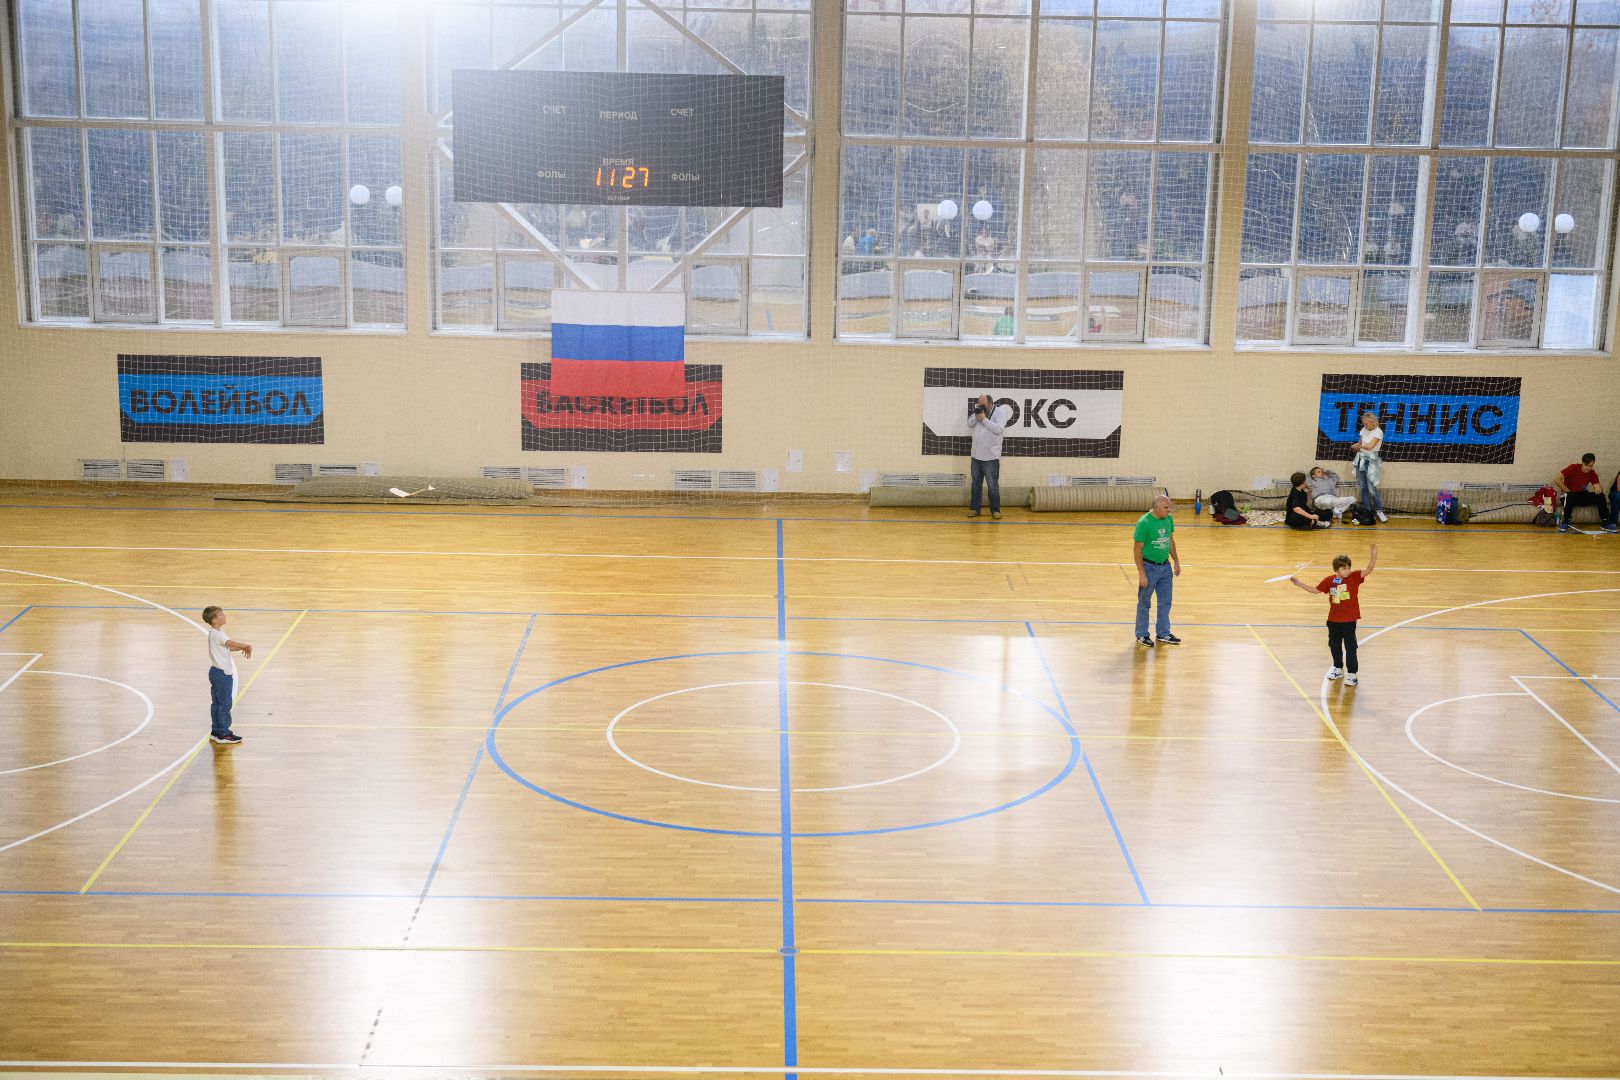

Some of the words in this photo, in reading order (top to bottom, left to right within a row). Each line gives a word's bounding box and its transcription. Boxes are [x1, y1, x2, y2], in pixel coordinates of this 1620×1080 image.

[599, 111, 638, 121] ПЕРИОД
[670, 108, 695, 117] СЧЕТ
[602, 157, 634, 166] ВРЕМЯ
[536, 170, 566, 179] ФОЛЫ
[670, 173, 700, 182] ФОЛЫ
[130, 384, 312, 416] ВОЛЕЙБОЛ
